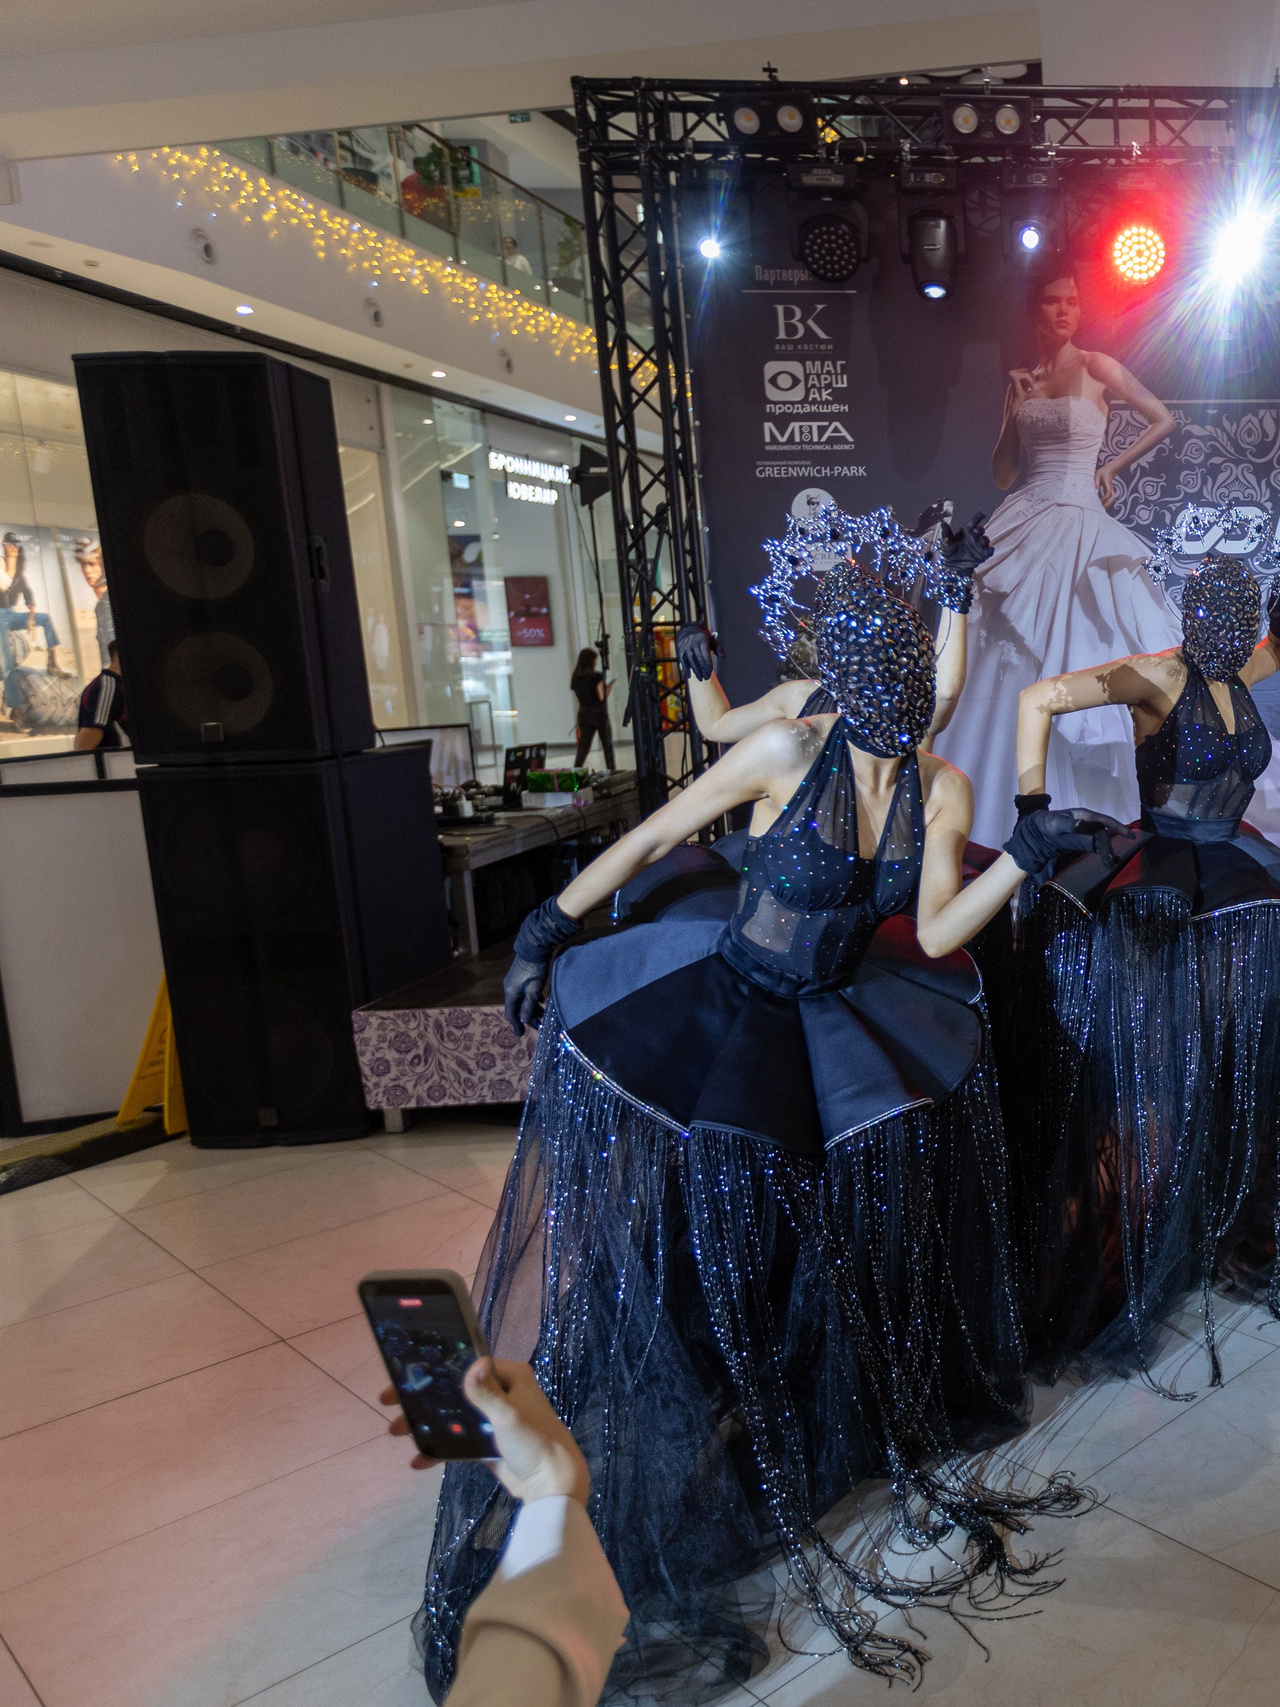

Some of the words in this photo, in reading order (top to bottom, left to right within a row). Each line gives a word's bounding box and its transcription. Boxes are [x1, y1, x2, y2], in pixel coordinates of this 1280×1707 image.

[806, 361, 846, 374] МАГ
[808, 375, 848, 388] АРШ
[808, 388, 833, 401] АК
[766, 404, 849, 415] продакшен
[756, 466, 867, 478] GREENWICH-PARK
[507, 481, 559, 506] ЮВЕЛИР
